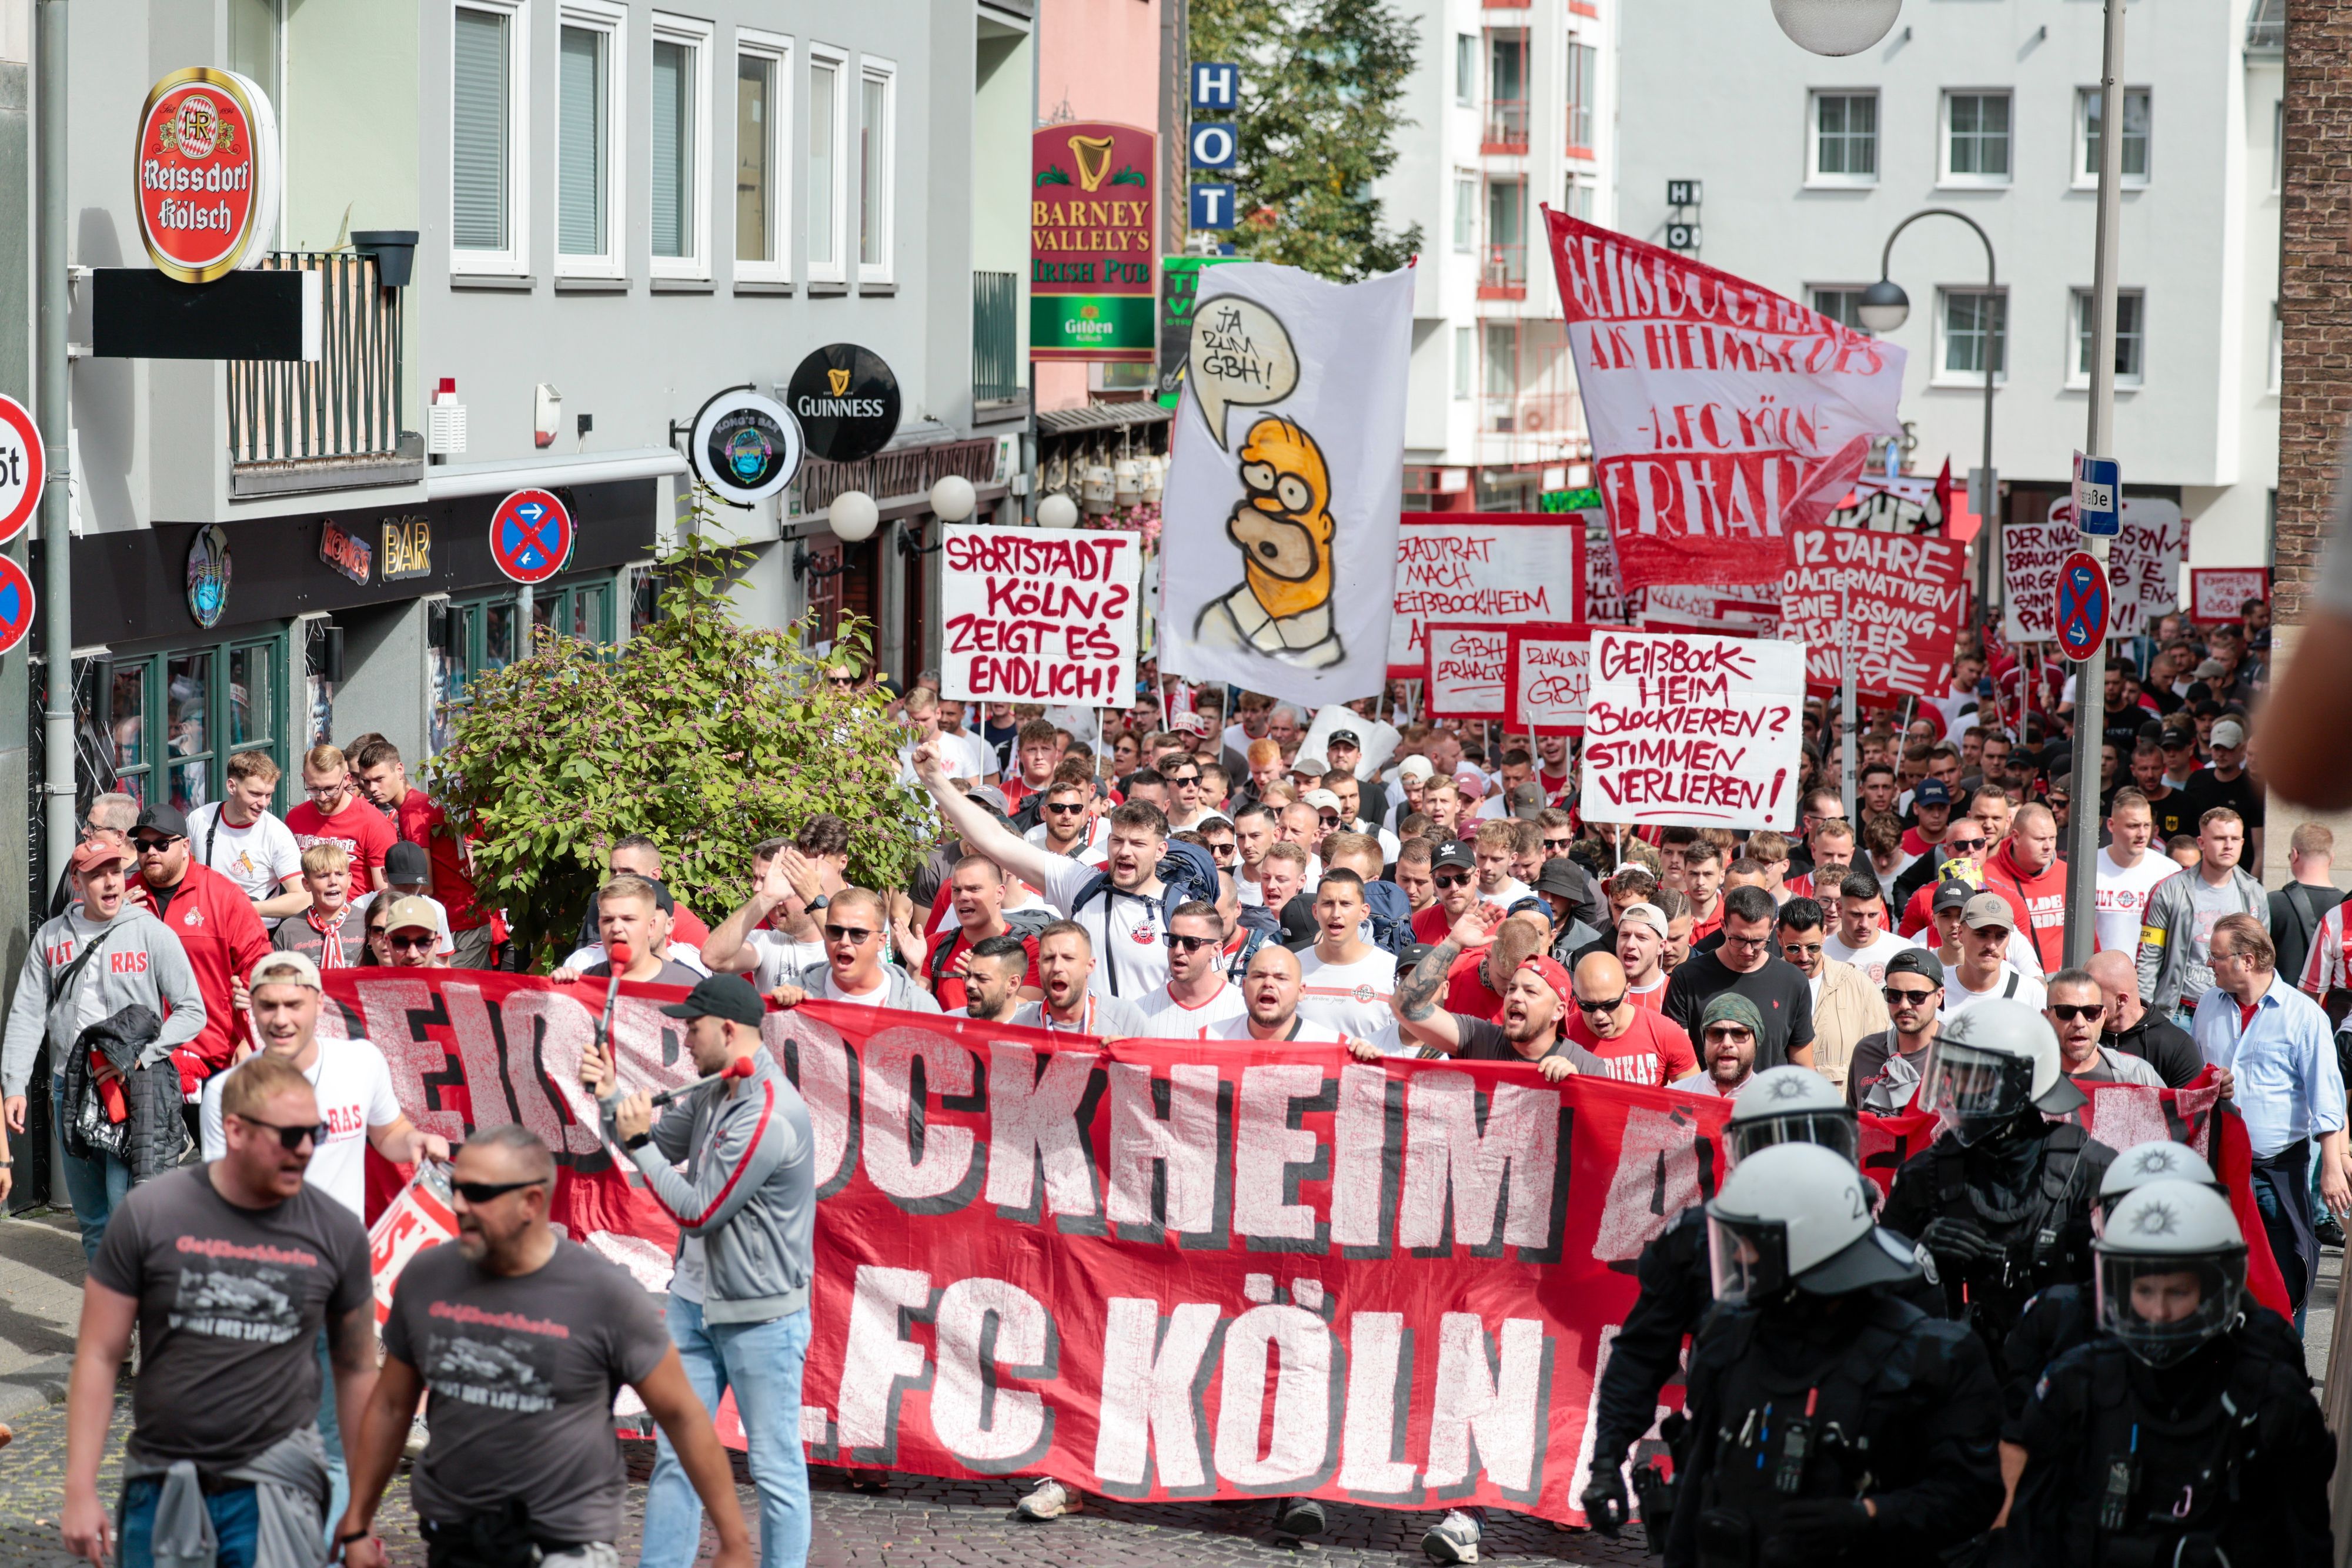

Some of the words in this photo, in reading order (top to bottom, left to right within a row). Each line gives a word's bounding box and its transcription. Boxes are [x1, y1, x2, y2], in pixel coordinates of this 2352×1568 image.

[159, 103, 176, 114] Seit
[185, 111, 211, 140] HR
[143, 158, 249, 193] Reissdorf
[158, 198, 232, 235] Kölsch
[1032, 200, 1150, 228] BARNEY
[1031, 230, 1151, 252] VALLELY'S
[1031, 258, 1095, 283] IRISH
[1102, 258, 1151, 283] PUB
[1064, 319, 1113, 335] Gilden
[1202, 330, 1260, 360] ZUM
[1202, 349, 1273, 390] GBH!
[797, 395, 885, 418] GUINNESS
[715, 417, 756, 434] KONG'S
[759, 417, 781, 434] BAR
[2080, 489, 2109, 507] straße
[323, 526, 370, 579] KONGS
[385, 522, 429, 574] BAR
[1397, 536, 1496, 564] STADTRAT
[2006, 527, 2045, 551] DER
[946, 534, 1128, 583] SPORTSTADT
[1793, 530, 1828, 567] 12
[1833, 531, 1955, 584] JAHRE
[1406, 561, 1475, 590] MACH
[1798, 566, 1959, 613] ALTERNATIVEN
[2006, 571, 2036, 593] IHR
[1394, 585, 1551, 618] EIßBOCKHEIM
[1780, 594, 1838, 621] EINE
[946, 613, 1061, 654] ZEIGT
[1065, 623, 1120, 660] ES
[1449, 634, 1506, 661] GBH
[1600, 636, 1756, 681] GEIßBOCK-
[969, 655, 1120, 705] ENDLICH!
[1528, 670, 1591, 707] GBH
[1638, 673, 1729, 708] HEIM
[1587, 701, 1791, 741] BLOCKIEREN?
[1585, 738, 1746, 771] STIMMEN
[1598, 767, 1787, 824] VERLIEREN!
[2025, 894, 2064, 911] LDE
[2030, 913, 2064, 929] RDE
[110, 951, 148, 974] RAS
[249, 973, 1573, 1264] EIßBOCKHEIM
[327, 1104, 362, 1135] RAS
[1094, 1273, 1557, 1508] KÖLN
